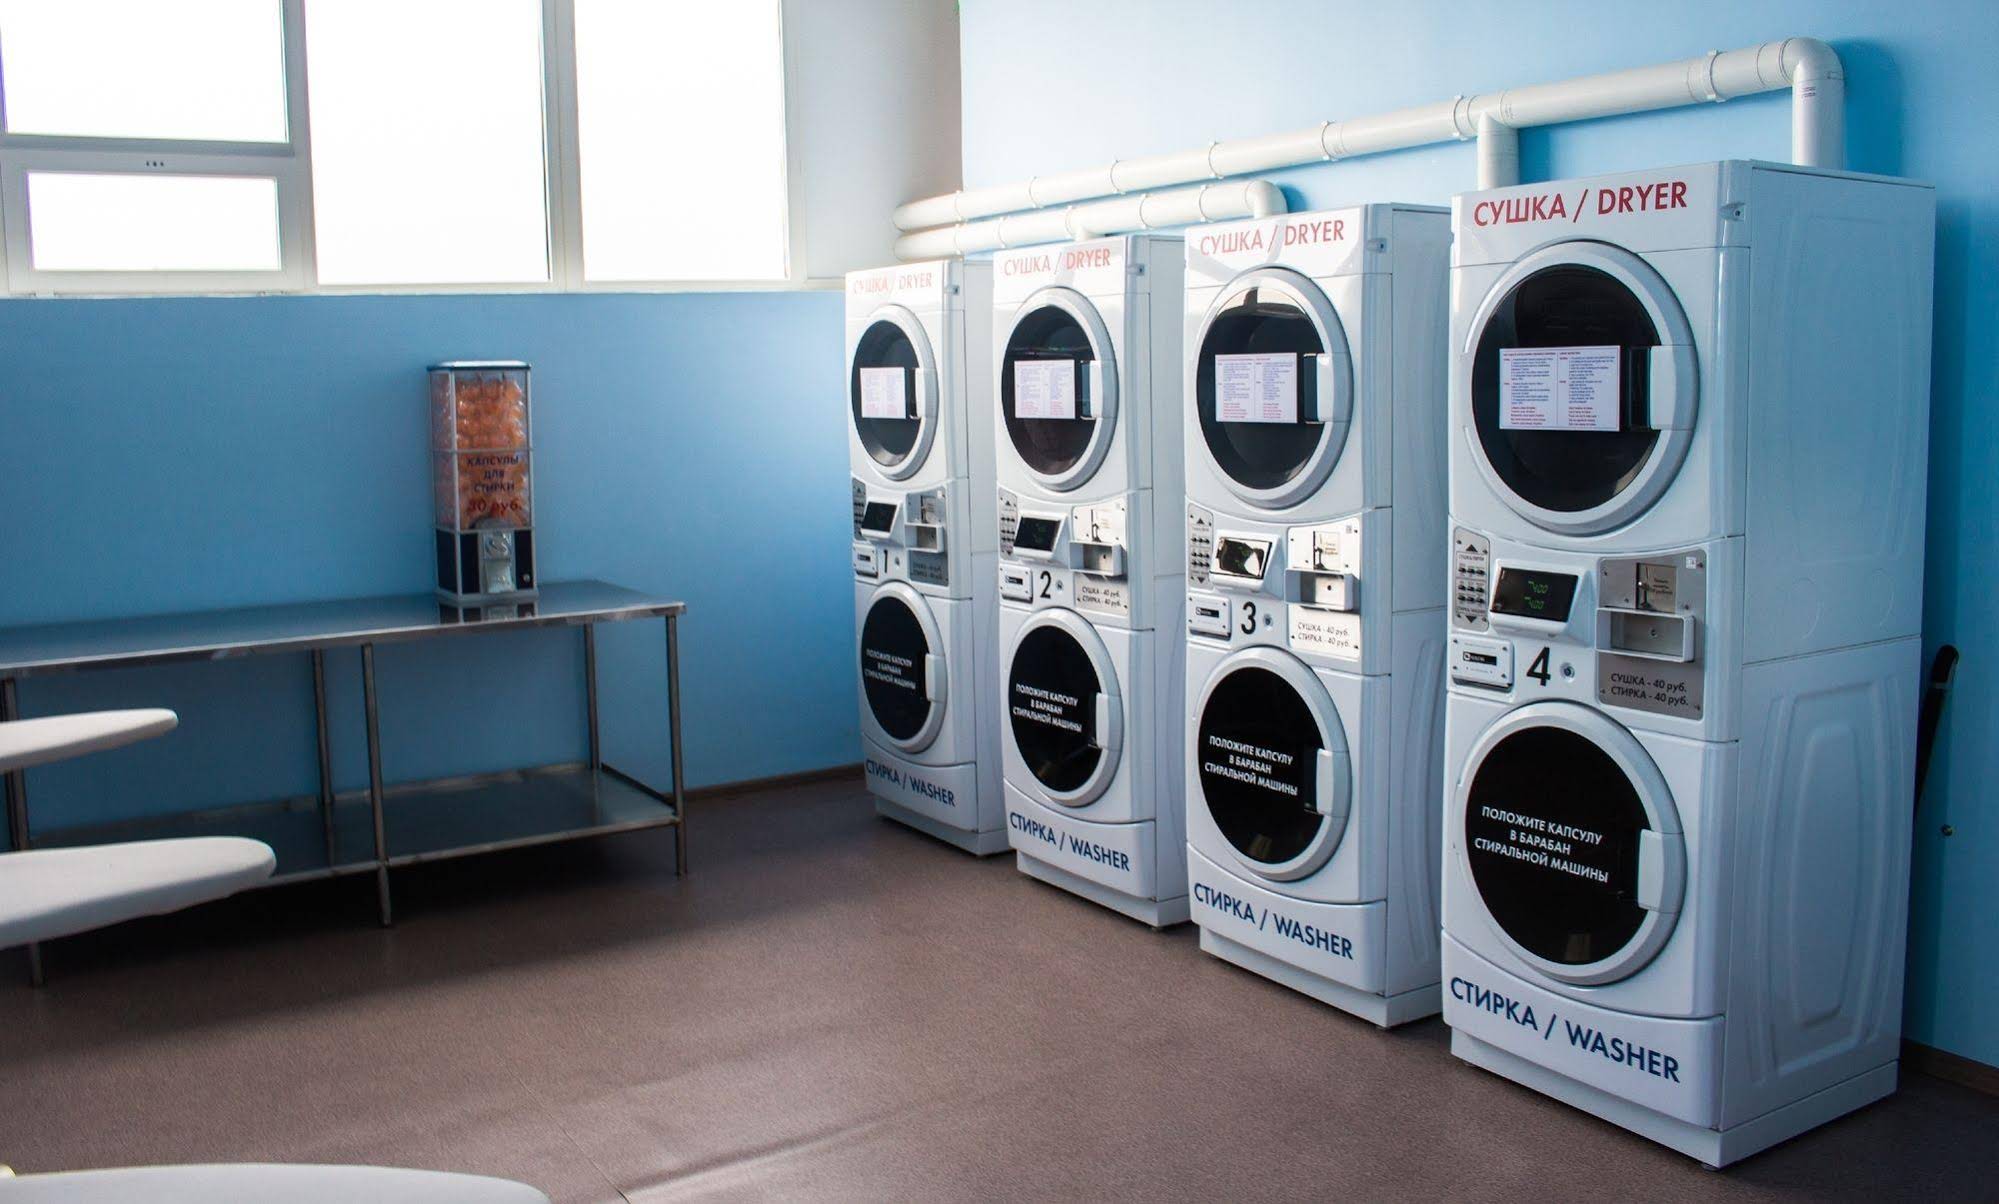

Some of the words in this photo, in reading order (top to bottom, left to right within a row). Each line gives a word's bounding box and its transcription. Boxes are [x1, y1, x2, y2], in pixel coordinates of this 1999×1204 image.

[1474, 192, 1566, 227] СУШКА
[1573, 188, 1588, 223] /
[1598, 181, 1688, 215] DRYER
[1200, 229, 1263, 256] СУШКА
[1268, 225, 1278, 254] /
[1284, 220, 1344, 246] DRYER
[1004, 258, 1051, 277] СУШКА
[1066, 248, 1111, 270] DRYER
[853, 280, 889, 294] СУШКА
[898, 272, 932, 290] DRYER
[467, 455, 519, 466] КАПСУЛЫ
[484, 469, 504, 480] ДЛЯ
[474, 482, 515, 493] СТИРКИ
[883, 549, 889, 574] 1
[1040, 570, 1051, 599] 2
[1241, 601, 1256, 635] 3
[1298, 622, 1321, 632] СУШКА
[1327, 626, 1334, 634] 40
[1336, 629, 1350, 638] руб.
[1298, 632, 1322, 642] СТИРКА
[1328, 637, 1336, 645] 40
[1337, 640, 1351, 648] руб.
[1526, 646, 1551, 686] 4
[1016, 683, 1049, 700] ПОЛОЖИТЕ
[1050, 692, 1078, 707] КАПСУЛУ
[1610, 673, 1645, 686] СУШКА
[1653, 679, 1665, 689] 40
[1666, 682, 1687, 694] руб.
[1611, 686, 1646, 700] СТИРКА
[1654, 693, 1666, 702] 40
[1668, 696, 1689, 706] руб.
[1012, 706, 1051, 723] СТИРАЛЬНОЙ
[1052, 716, 1082, 733] МАШИНЫ
[1030, 698, 1034, 708] В
[1036, 700, 1063, 715] БАРАБАН
[1209, 735, 1254, 755] ПОЛОЖИТЕ
[1255, 746, 1294, 766] КАПСУЛУ
[1228, 754, 1234, 764] В
[1236, 756, 1272, 775] БАРАБАН
[866, 759, 900, 786] СТИРКА
[910, 776, 956, 808] WASHER
[1204, 762, 1256, 785] СТИРАЛЬНОЙ
[1258, 776, 1298, 796] МАШИНЫ
[1481, 806, 1546, 831] ПОЛОЖИТЕ
[1548, 822, 1602, 846] КАПСУЛУ
[1010, 812, 1057, 845] СТИРКА
[1060, 832, 1066, 851] /
[1069, 834, 1130, 872] WASHER
[1510, 830, 1517, 841] В
[1520, 832, 1572, 856] БАРАБАН
[1474, 838, 1548, 867] СТИРАЛЬНОЙ
[1550, 856, 1608, 884] МАШИНЫ
[1194, 882, 1256, 924] СТИРКА
[1260, 909, 1268, 931] /
[1274, 912, 1353, 960] WASHER
[1450, 976, 1538, 1031] СТИРКА
[1544, 1013, 1556, 1041] /
[1565, 1020, 1680, 1083] WASHER
